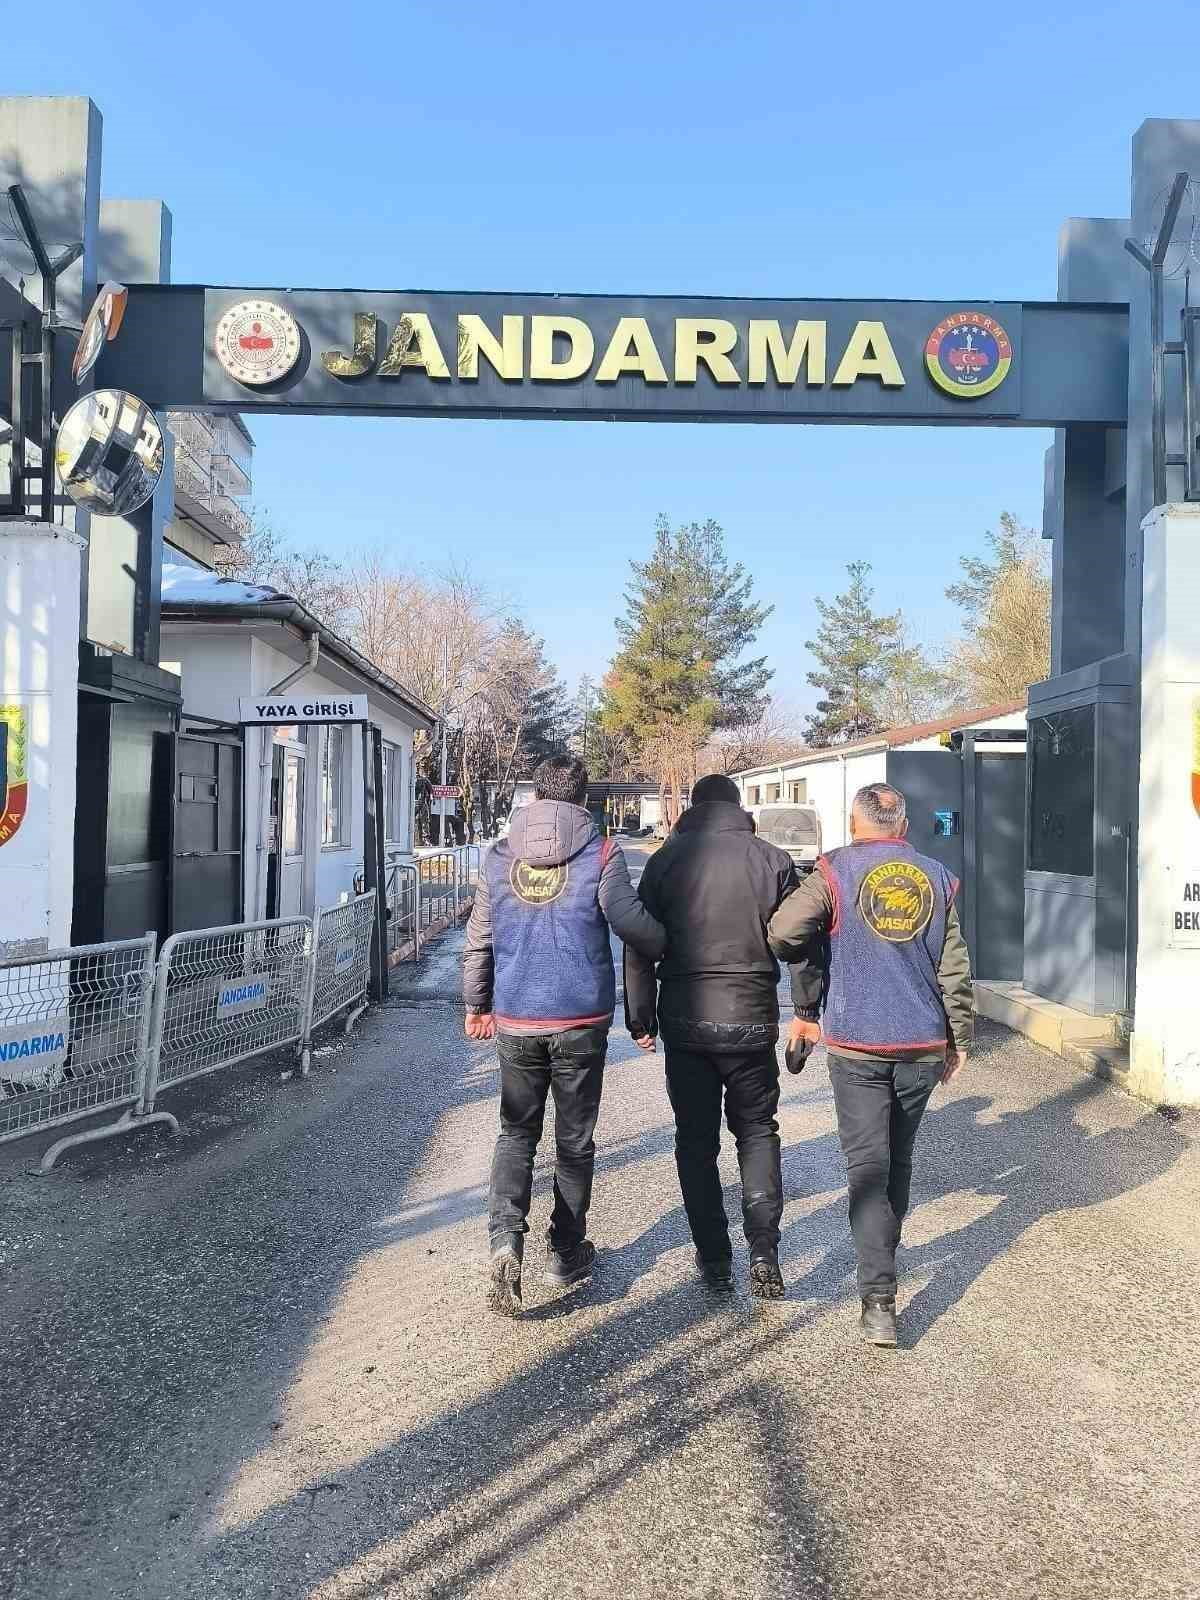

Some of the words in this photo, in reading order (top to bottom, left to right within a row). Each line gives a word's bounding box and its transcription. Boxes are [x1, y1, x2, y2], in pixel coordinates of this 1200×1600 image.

[320, 312, 907, 386] JANDARMA
[256, 705, 297, 717] YAYA
[302, 701, 354, 717] GİRİŞİ
[867, 865, 929, 892] JANDARMA
[521, 886, 555, 897] JASAT
[219, 983, 265, 1006] JANDARMA
